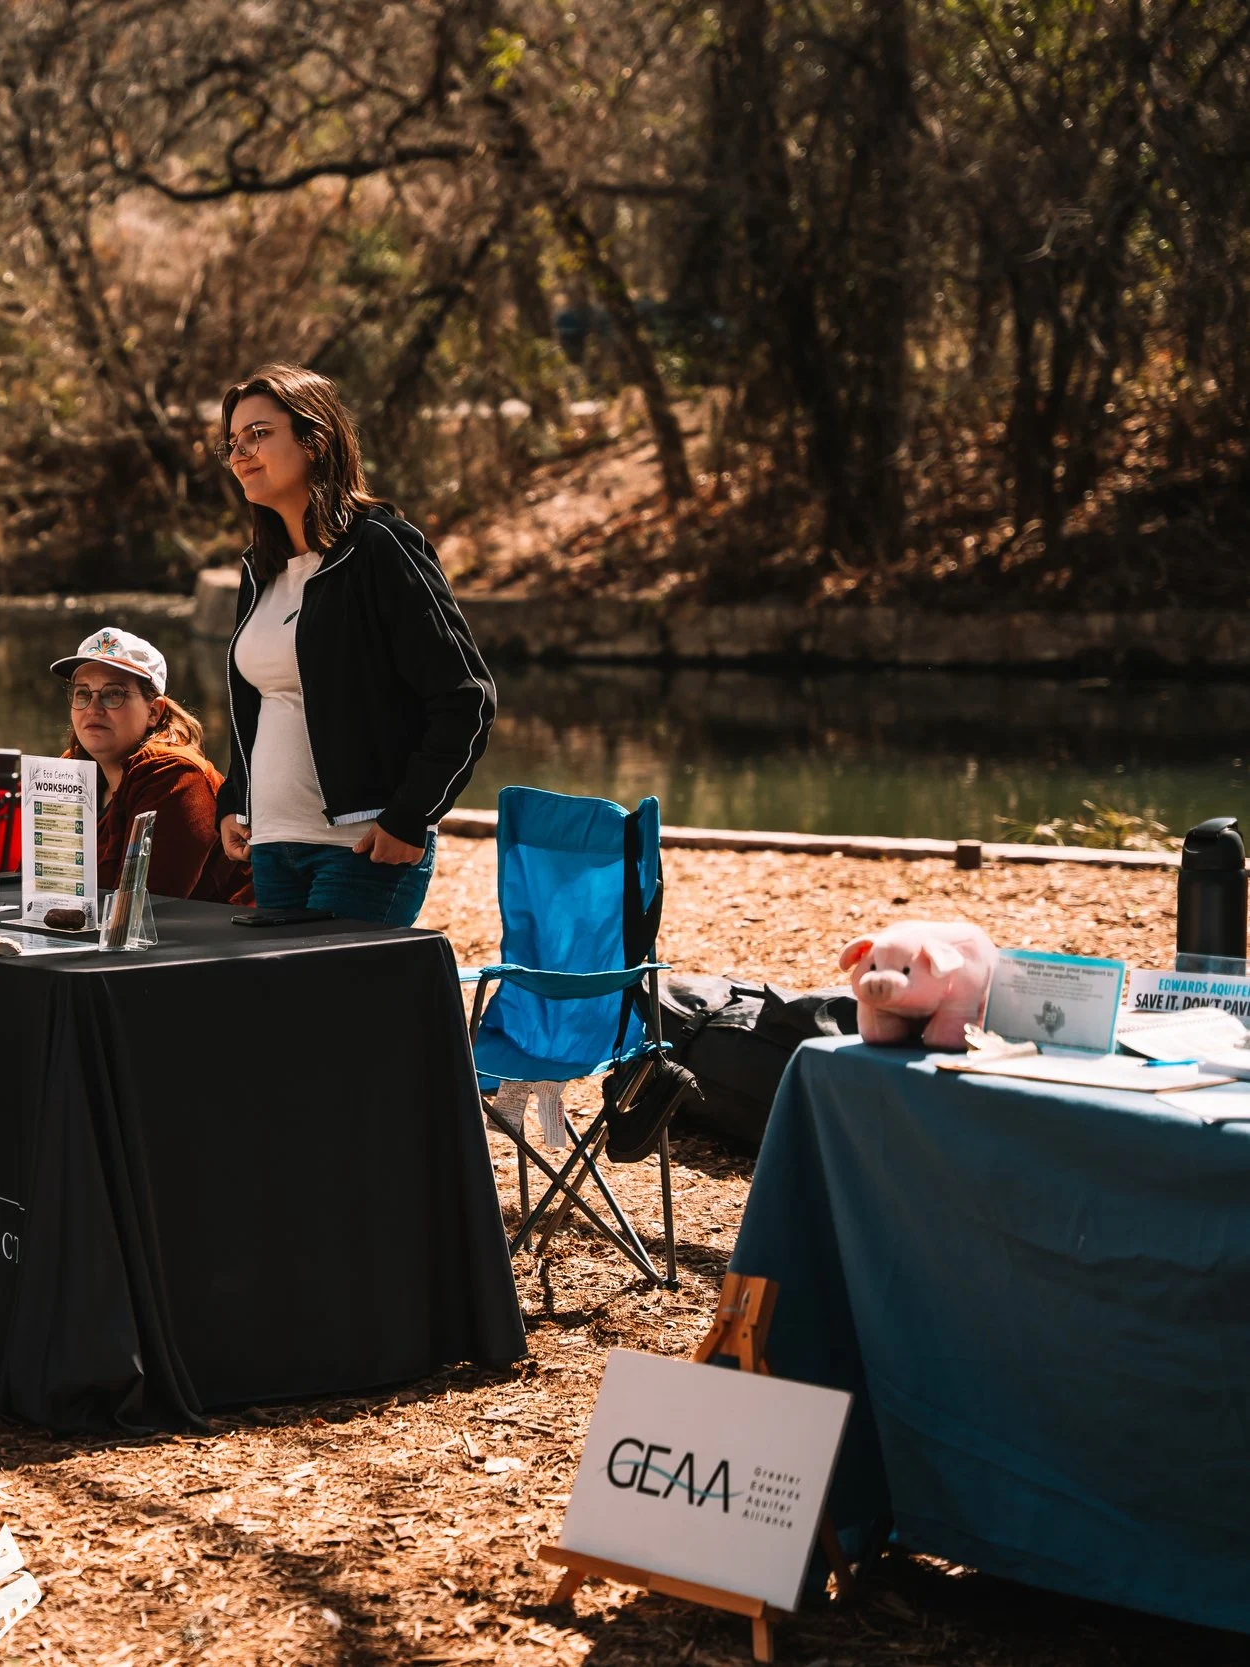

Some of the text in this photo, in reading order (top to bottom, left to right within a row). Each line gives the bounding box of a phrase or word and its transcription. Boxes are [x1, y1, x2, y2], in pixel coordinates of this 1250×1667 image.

[43, 769, 74, 780] Eco Centro
[35, 782, 83, 795] WORKSHOPS
[1158, 978, 1250, 998] EDWARDS AQUIFE
[1135, 993, 1164, 1009] SAVE
[607, 1437, 729, 1513] GEAA
[753, 1466, 801, 1485] Greater
[750, 1480, 800, 1500] Edwards
[746, 1494, 791, 1513] Aquifer
[742, 1509, 793, 1529] Alliance
